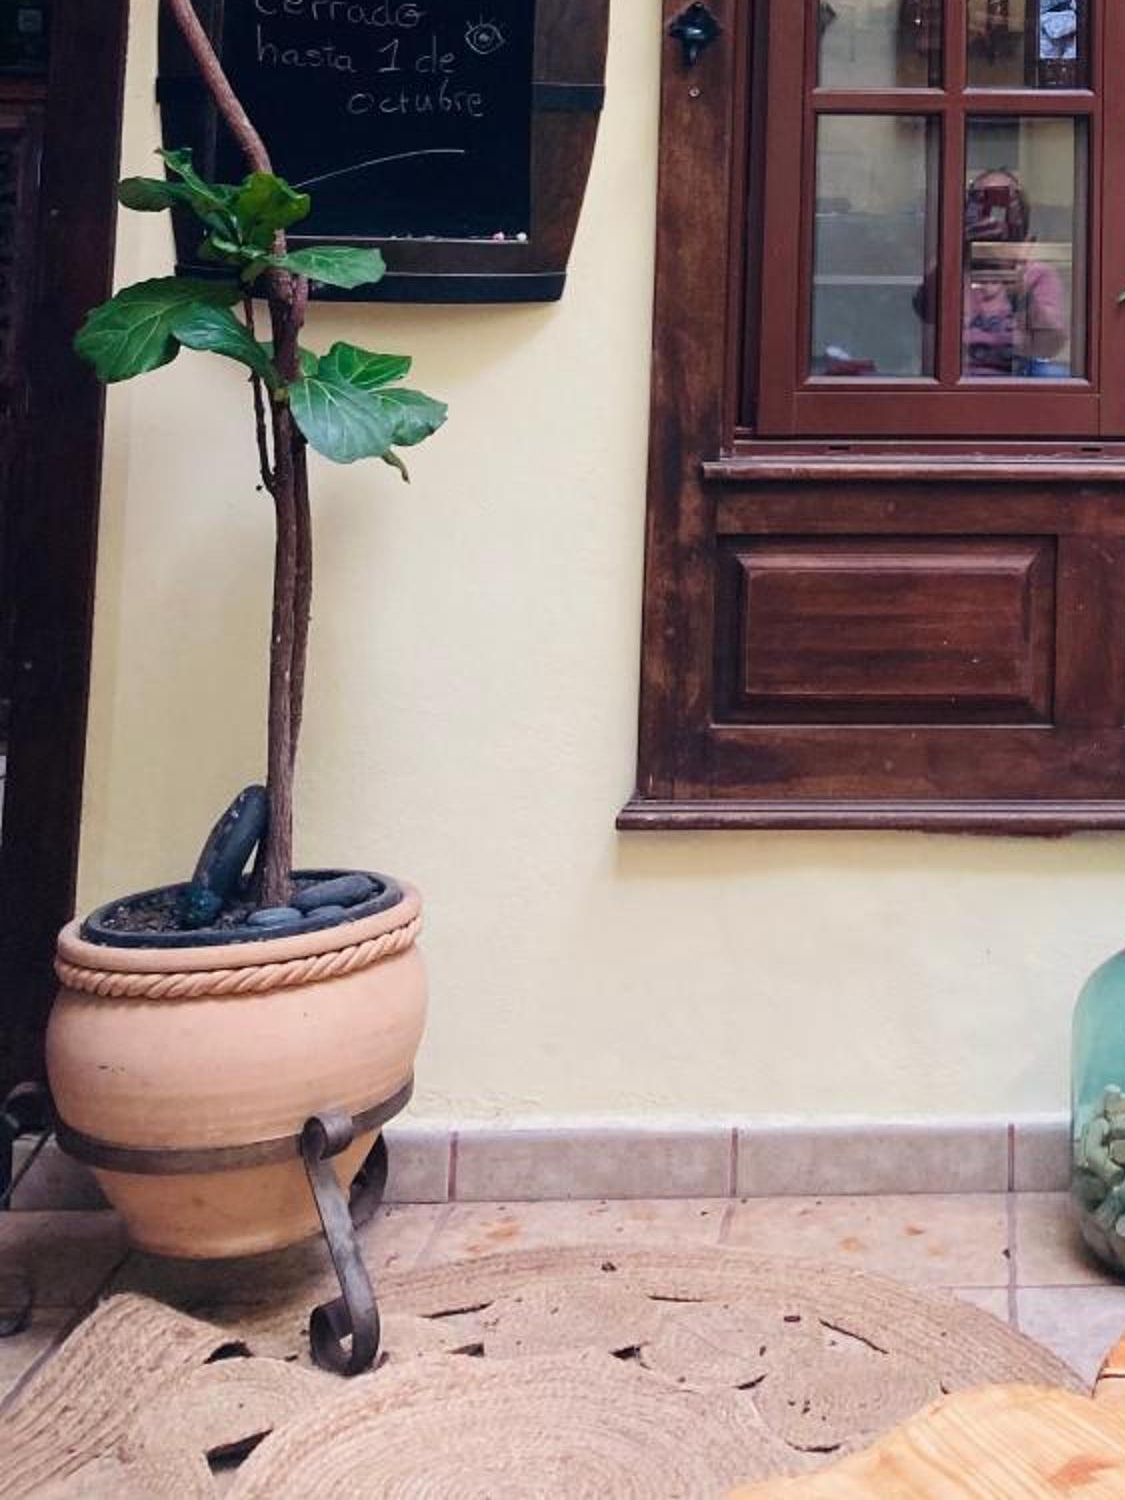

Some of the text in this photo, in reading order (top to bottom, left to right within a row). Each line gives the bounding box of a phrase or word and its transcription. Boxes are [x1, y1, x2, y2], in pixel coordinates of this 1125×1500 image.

[257, 24, 455, 73] hasta 1 de
[347, 79, 484, 117] octubre
